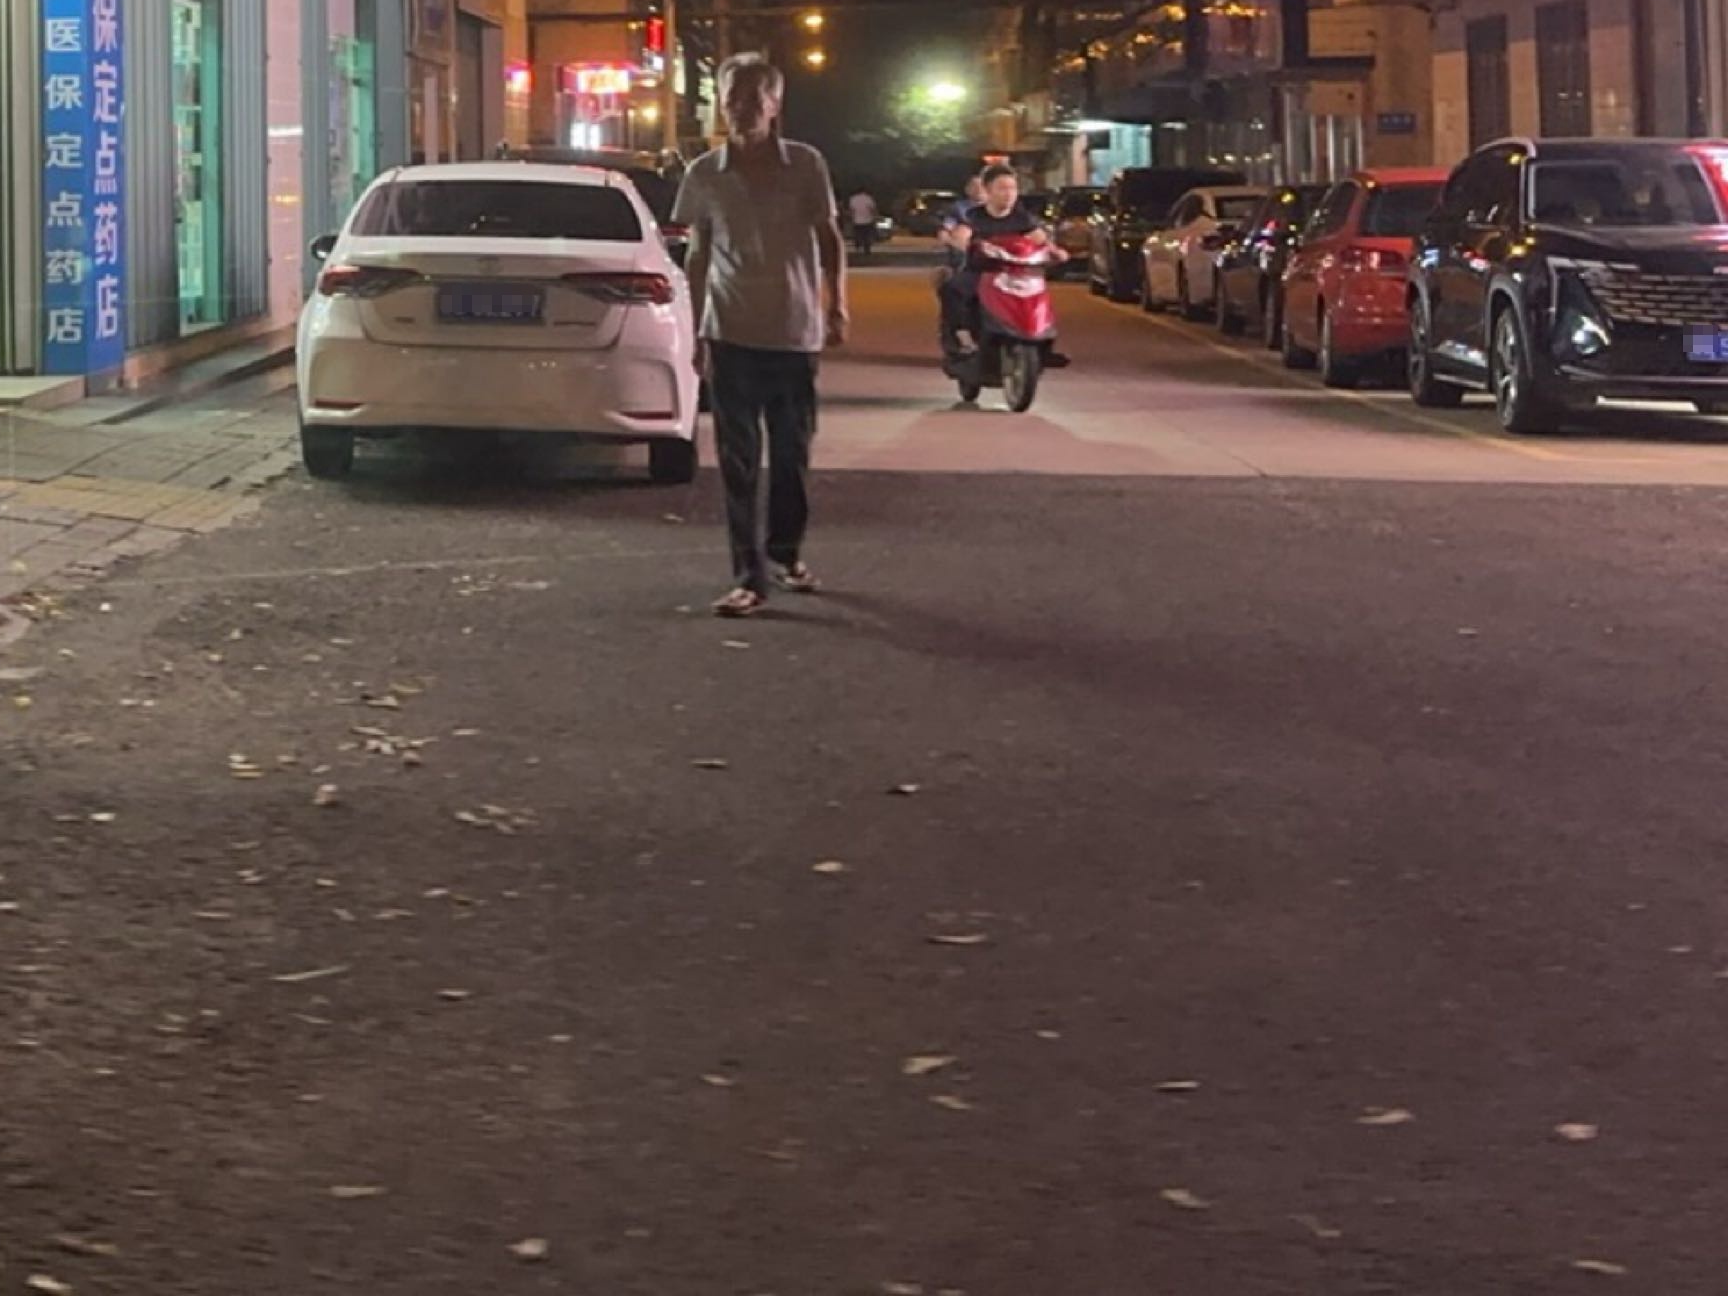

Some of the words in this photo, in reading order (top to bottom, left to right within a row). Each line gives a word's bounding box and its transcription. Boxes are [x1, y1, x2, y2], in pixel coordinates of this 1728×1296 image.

[44, 18, 84, 346] 医保定点药店
